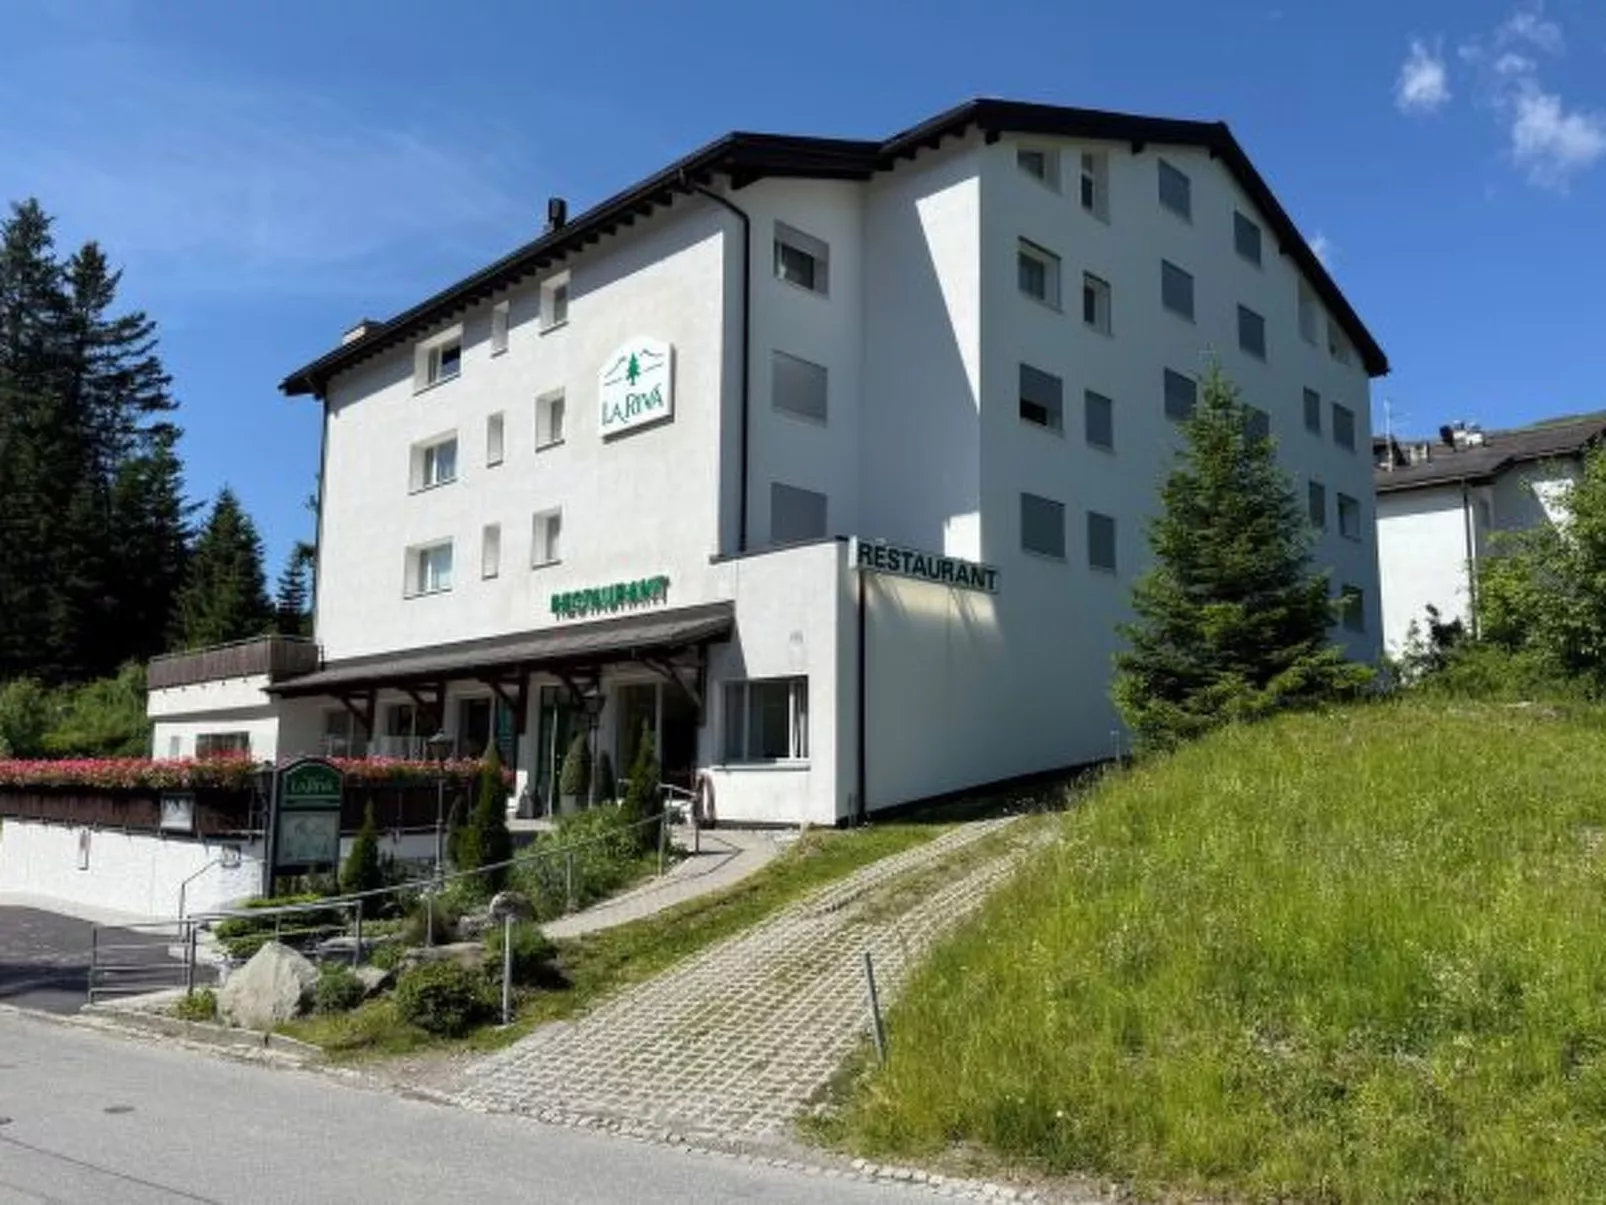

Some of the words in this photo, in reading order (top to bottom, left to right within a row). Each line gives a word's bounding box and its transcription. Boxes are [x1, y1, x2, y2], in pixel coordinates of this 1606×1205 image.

[602, 402, 628, 426] LA
[625, 383, 664, 419] RIVA
[858, 543, 998, 590] RESTAURANT
